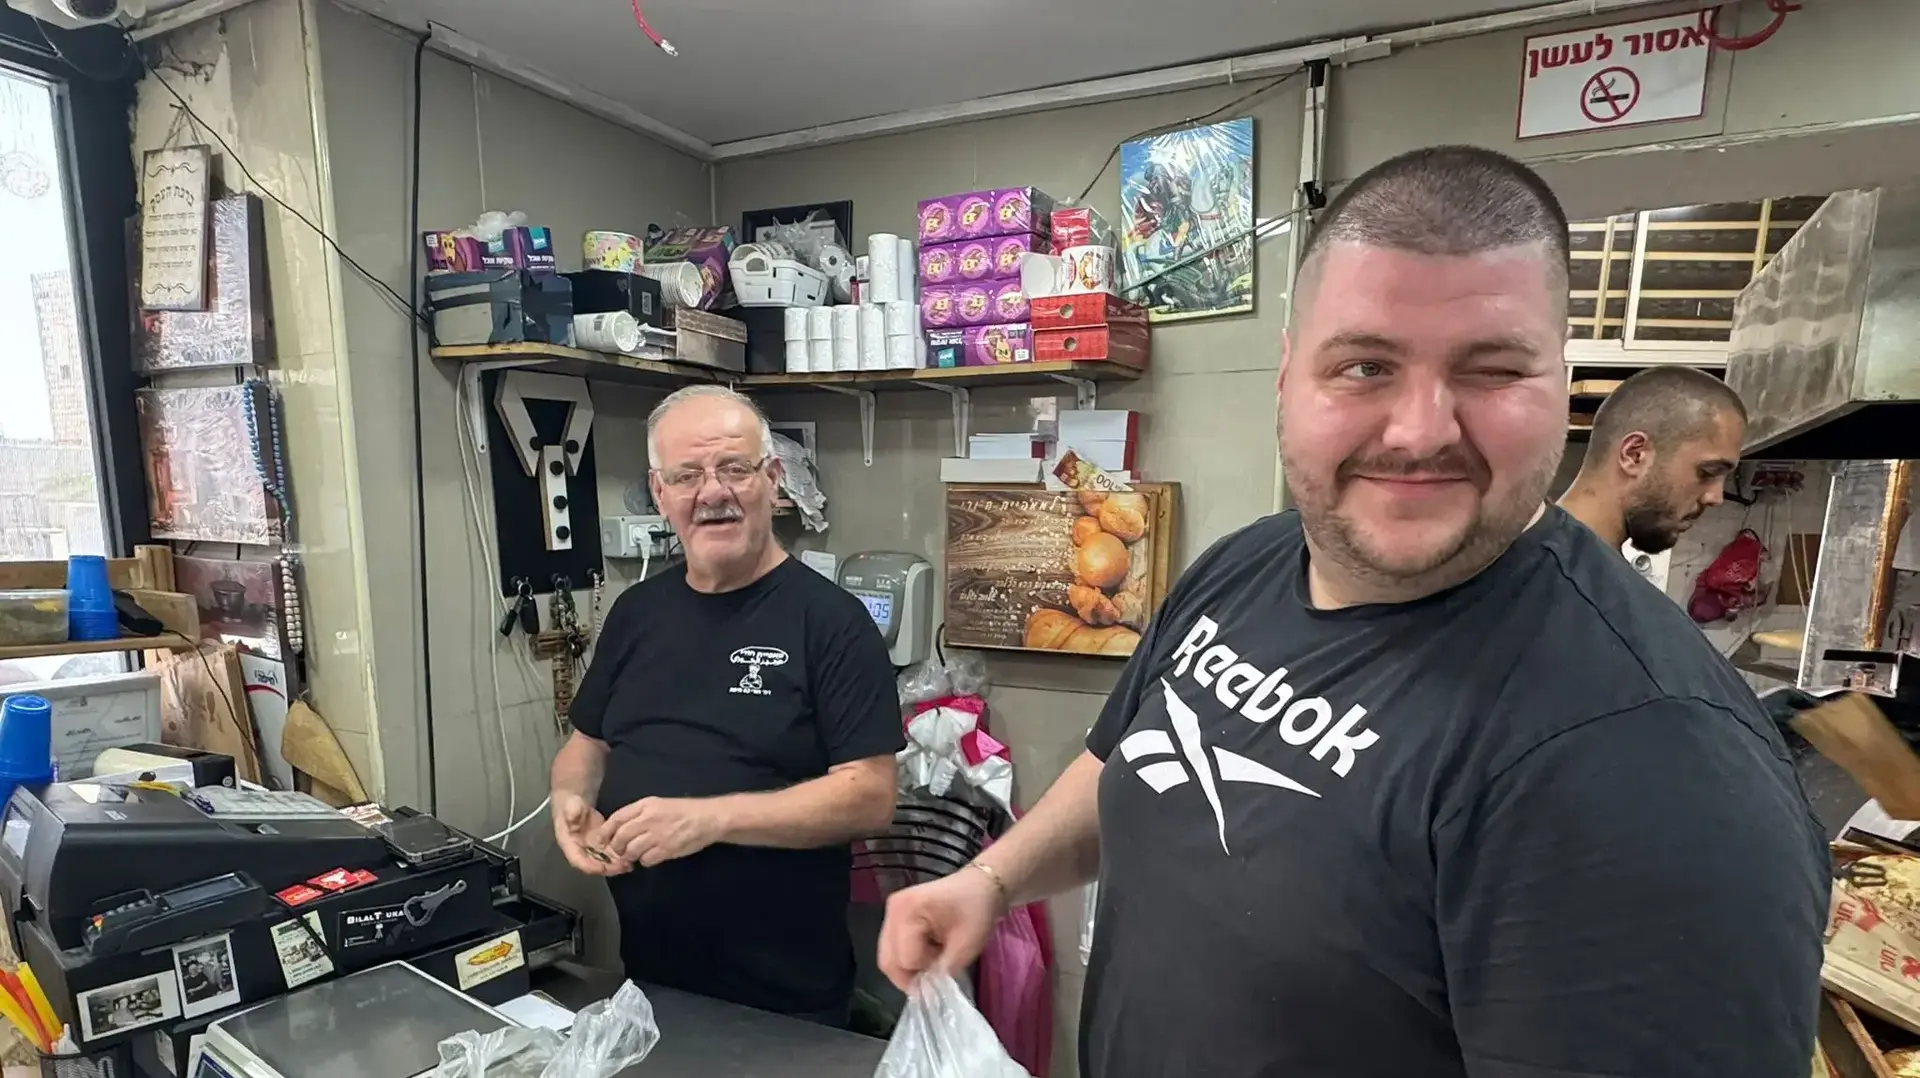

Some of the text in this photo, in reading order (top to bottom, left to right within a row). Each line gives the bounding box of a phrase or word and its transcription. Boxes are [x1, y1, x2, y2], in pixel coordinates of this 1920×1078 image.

[1528, 25, 1706, 78] אסור לעשן
[1171, 614, 1380, 778] Reebok
